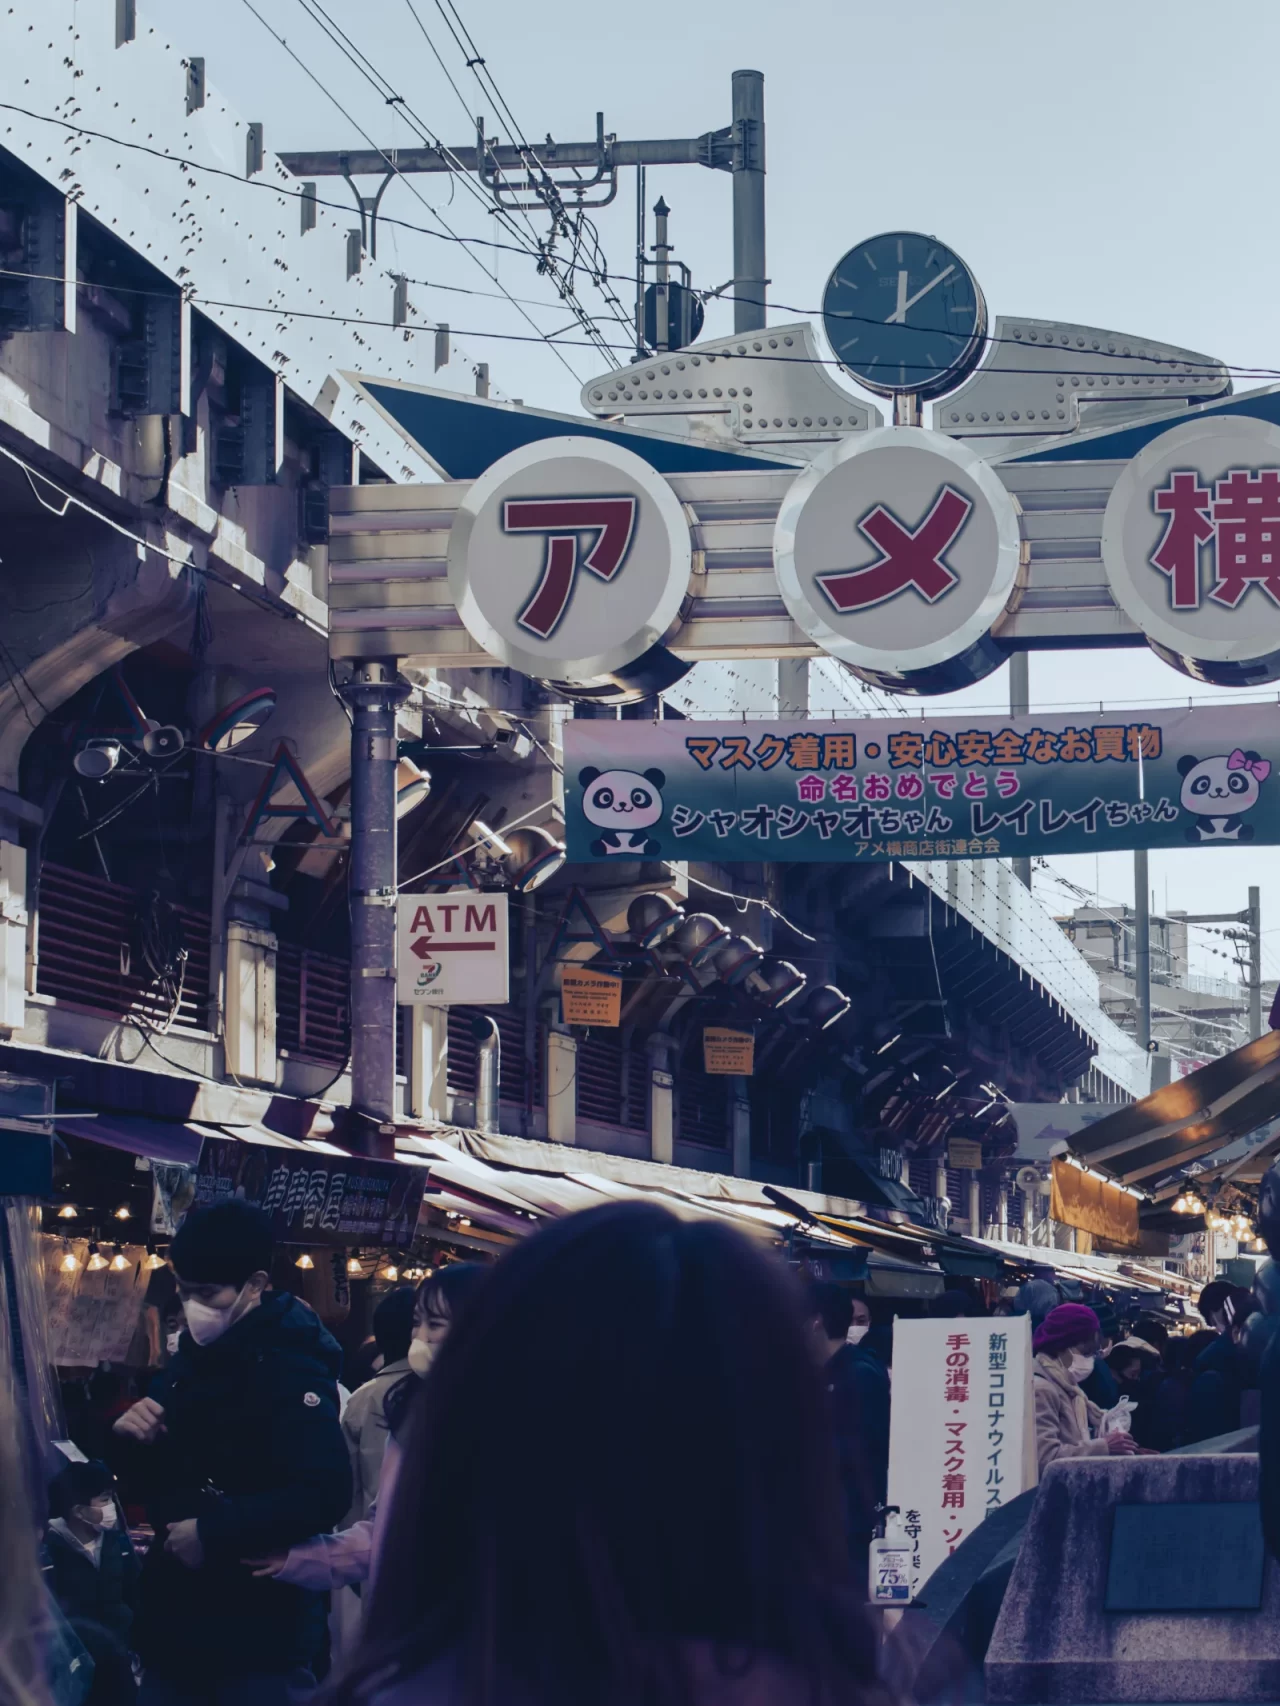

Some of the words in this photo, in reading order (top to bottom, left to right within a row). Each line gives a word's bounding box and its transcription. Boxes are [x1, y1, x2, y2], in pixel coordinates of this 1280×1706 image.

[685, 724, 1163, 772] マスク着用・安心安全なお買物
[796, 769, 1021, 803] 命名おめでとう
[671, 803, 953, 840] シャオシャオちゃん
[970, 797, 1179, 837] レイレイちゃん
[854, 837, 1000, 857] アメ横商店街連合会
[409, 904, 497, 934] ATM
[878, 1569, 908, 1584] 75%
